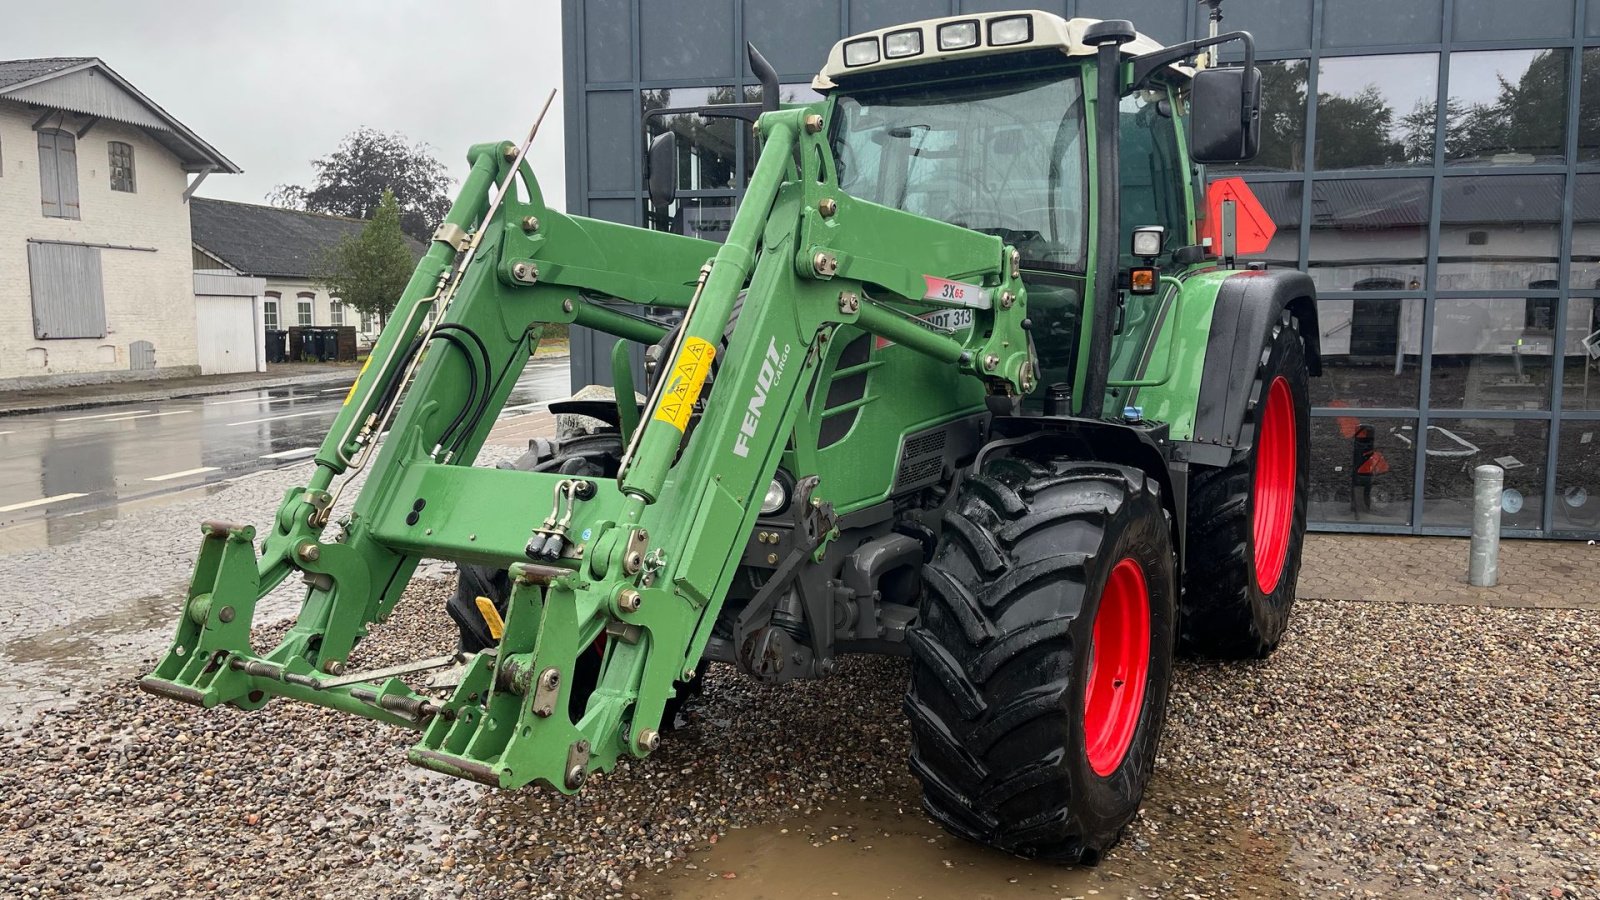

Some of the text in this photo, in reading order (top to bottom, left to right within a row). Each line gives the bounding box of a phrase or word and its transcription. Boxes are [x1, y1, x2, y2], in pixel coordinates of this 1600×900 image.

[942, 284, 964, 299] 3X65
[915, 309, 971, 331] NDT 313
[773, 344, 790, 386] CARGO
[733, 335, 780, 458] FENDT
